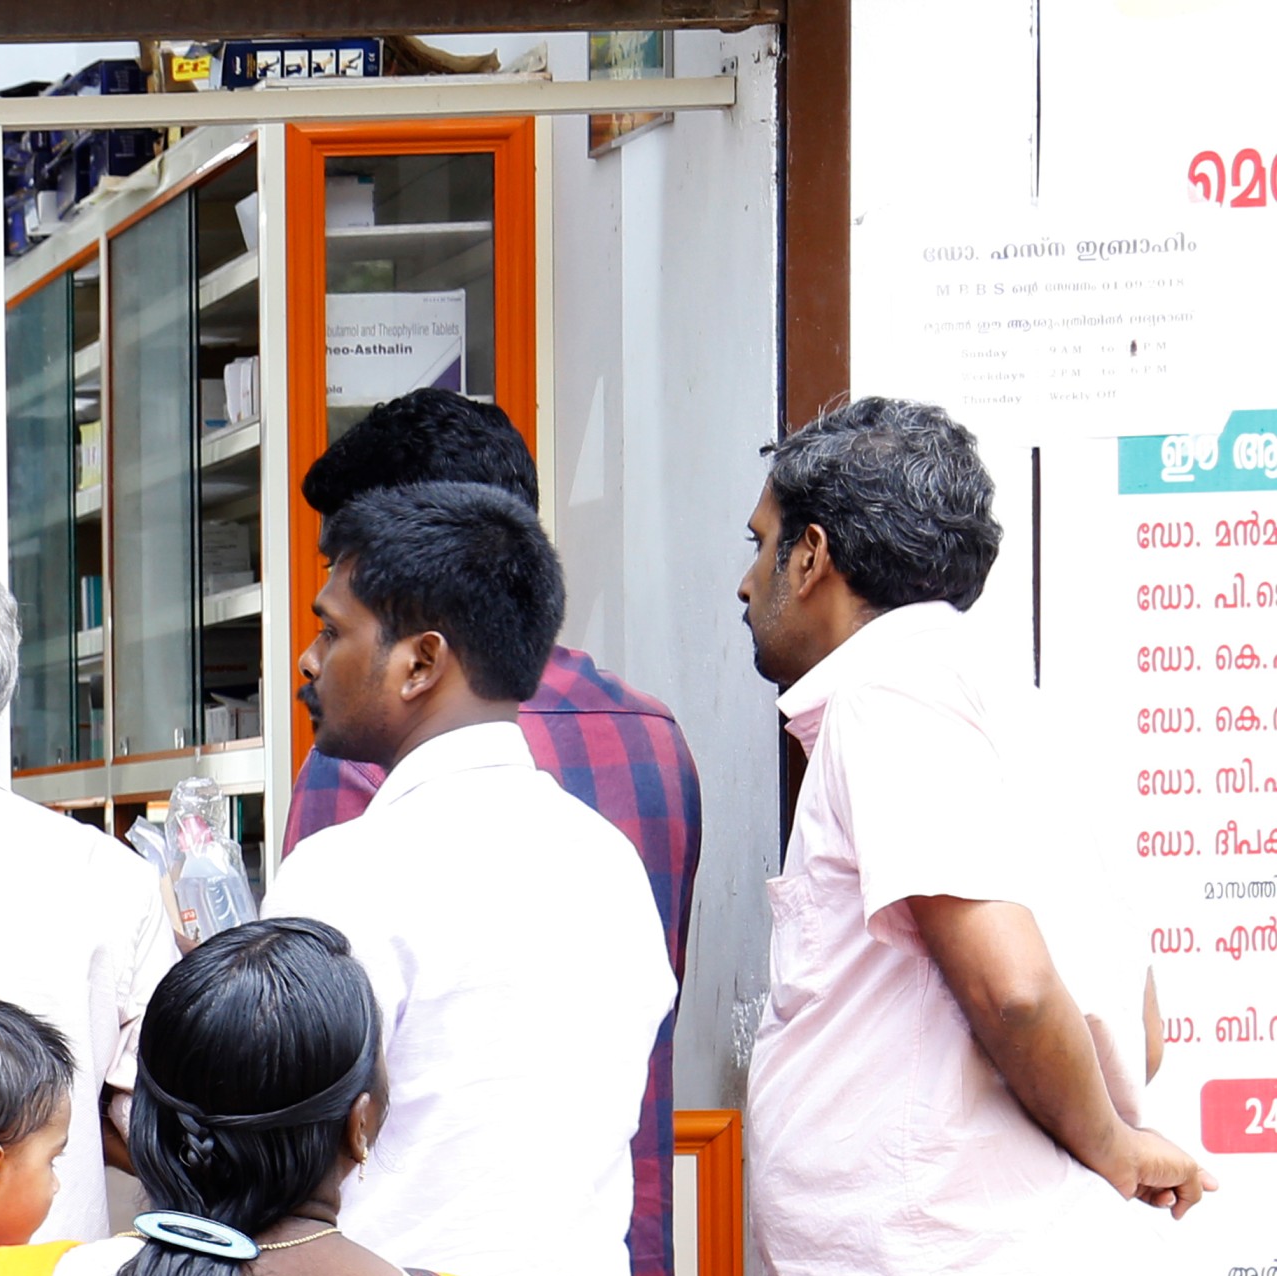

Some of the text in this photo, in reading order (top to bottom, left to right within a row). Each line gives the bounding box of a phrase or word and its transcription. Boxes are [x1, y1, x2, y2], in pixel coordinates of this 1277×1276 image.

[1188, 148, 1277, 207] മെ
[923, 232, 1197, 262] ഡോ. ഹസ്ന ഇബ്രാഹിം
[361, 324, 376, 336] and
[379, 323, 429, 338] Theophylline
[432, 322, 459, 335] Tablets
[961, 349, 1008, 360] Sunday
[1101, 344, 1115, 353] to
[961, 371, 1026, 381] Weekdays
[1102, 367, 1115, 375] to
[962, 389, 1116, 404] Thursday Weekly Off
[1161, 434, 1219, 482] ഈ
[1137, 521, 1201, 549] ഡോ.
[1137, 584, 1201, 611] ഡോ.
[1137, 646, 1201, 672] ഡോ.
[1137, 707, 1201, 734] ഡോ.
[1137, 769, 1201, 795] ഡോ.
[1137, 830, 1201, 857] ഡോ.
